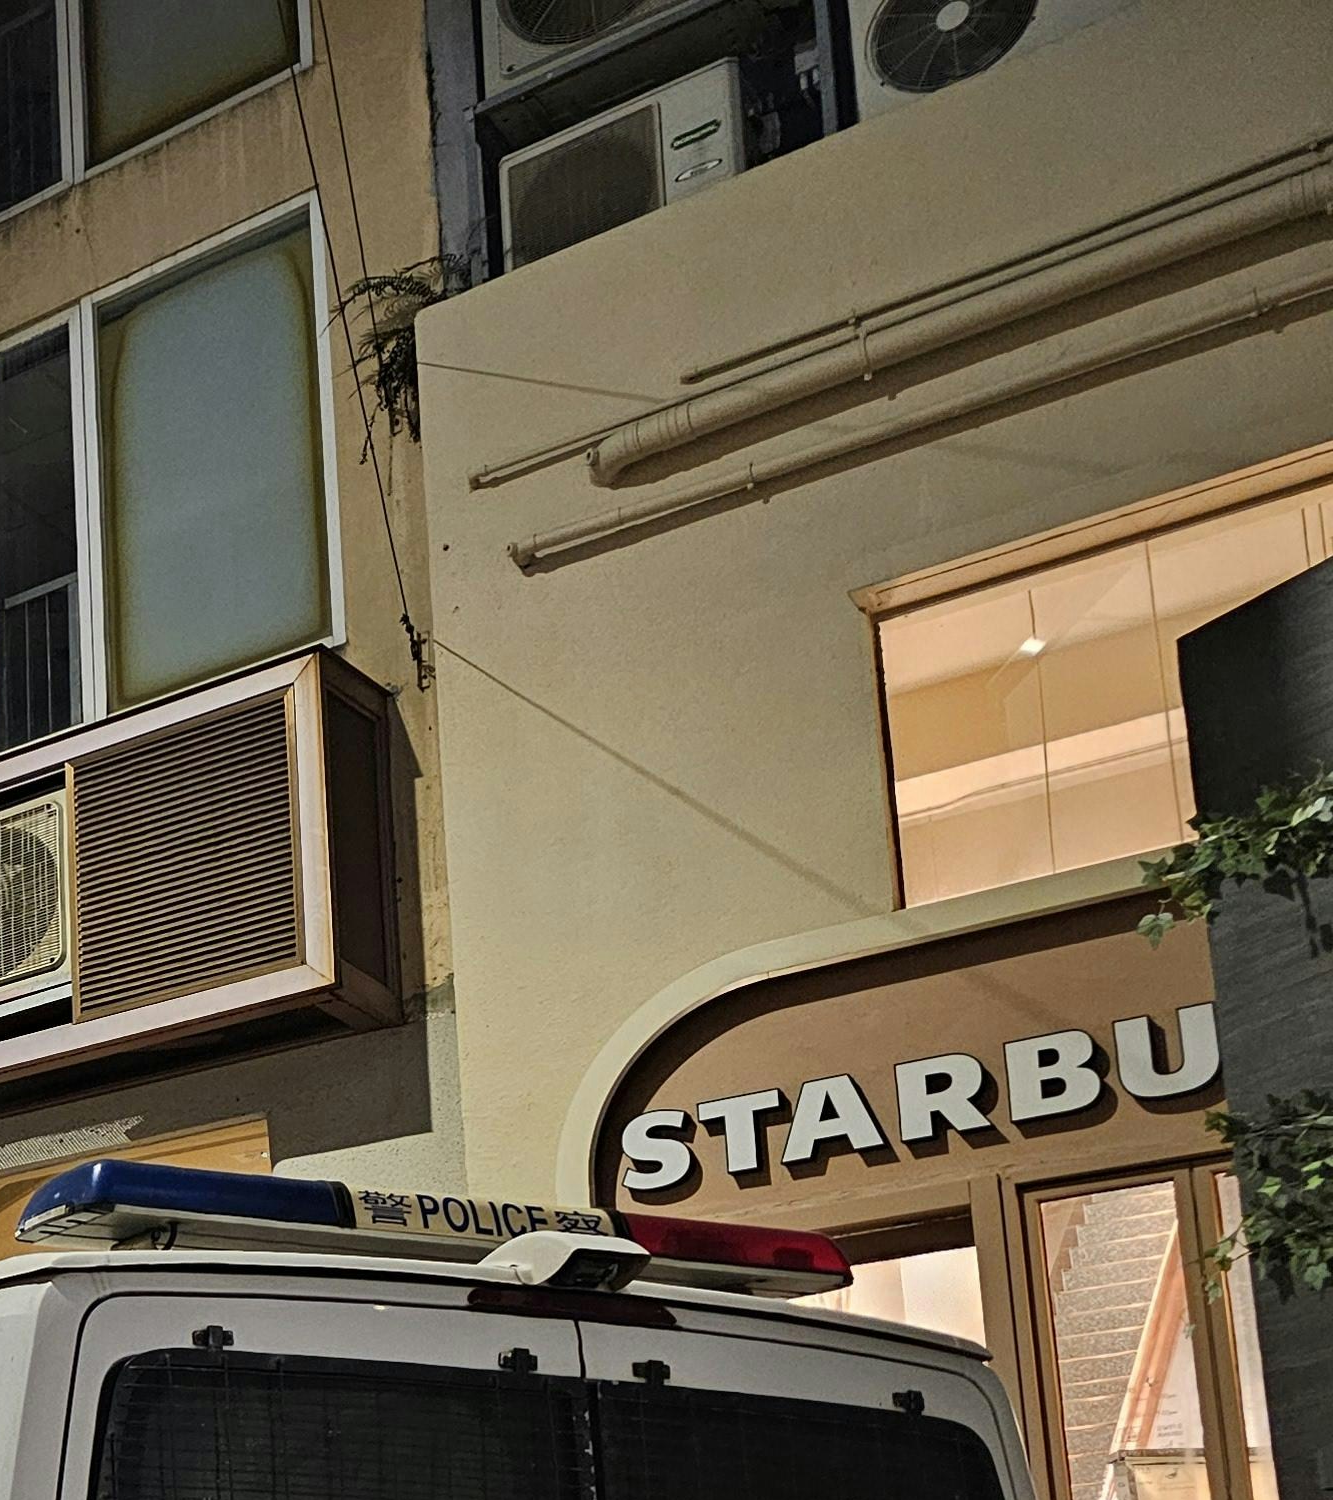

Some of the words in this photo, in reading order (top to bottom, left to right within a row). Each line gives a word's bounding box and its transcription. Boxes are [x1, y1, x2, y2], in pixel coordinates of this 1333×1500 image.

[622, 1002, 1221, 1190] STARBU
[358, 1190, 412, 1226] 警
[416, 1193, 548, 1238] POLICE
